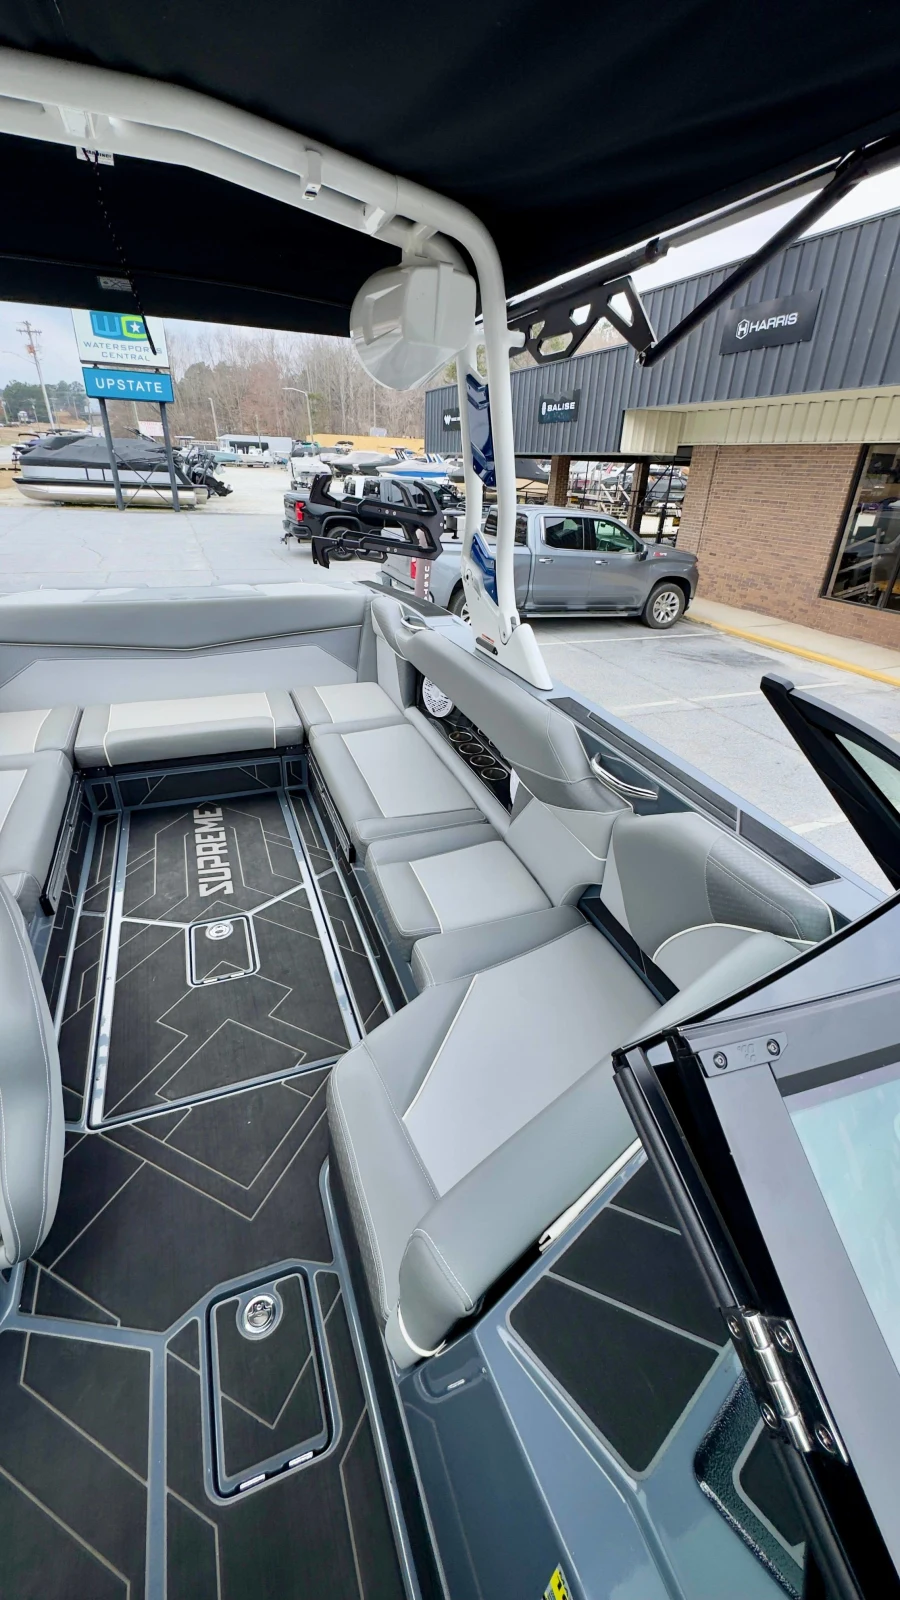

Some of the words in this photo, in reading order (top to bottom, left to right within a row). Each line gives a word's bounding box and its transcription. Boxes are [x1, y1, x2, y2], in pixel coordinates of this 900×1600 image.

[749, 312, 798, 333] HARRIS
[83, 341, 162, 354] WATERSPORS
[101, 351, 150, 361] CENTRAL
[95, 377, 163, 393] UPSTATE
[547, 401, 576, 412] BALISE
[193, 807, 234, 897] SUPREME
